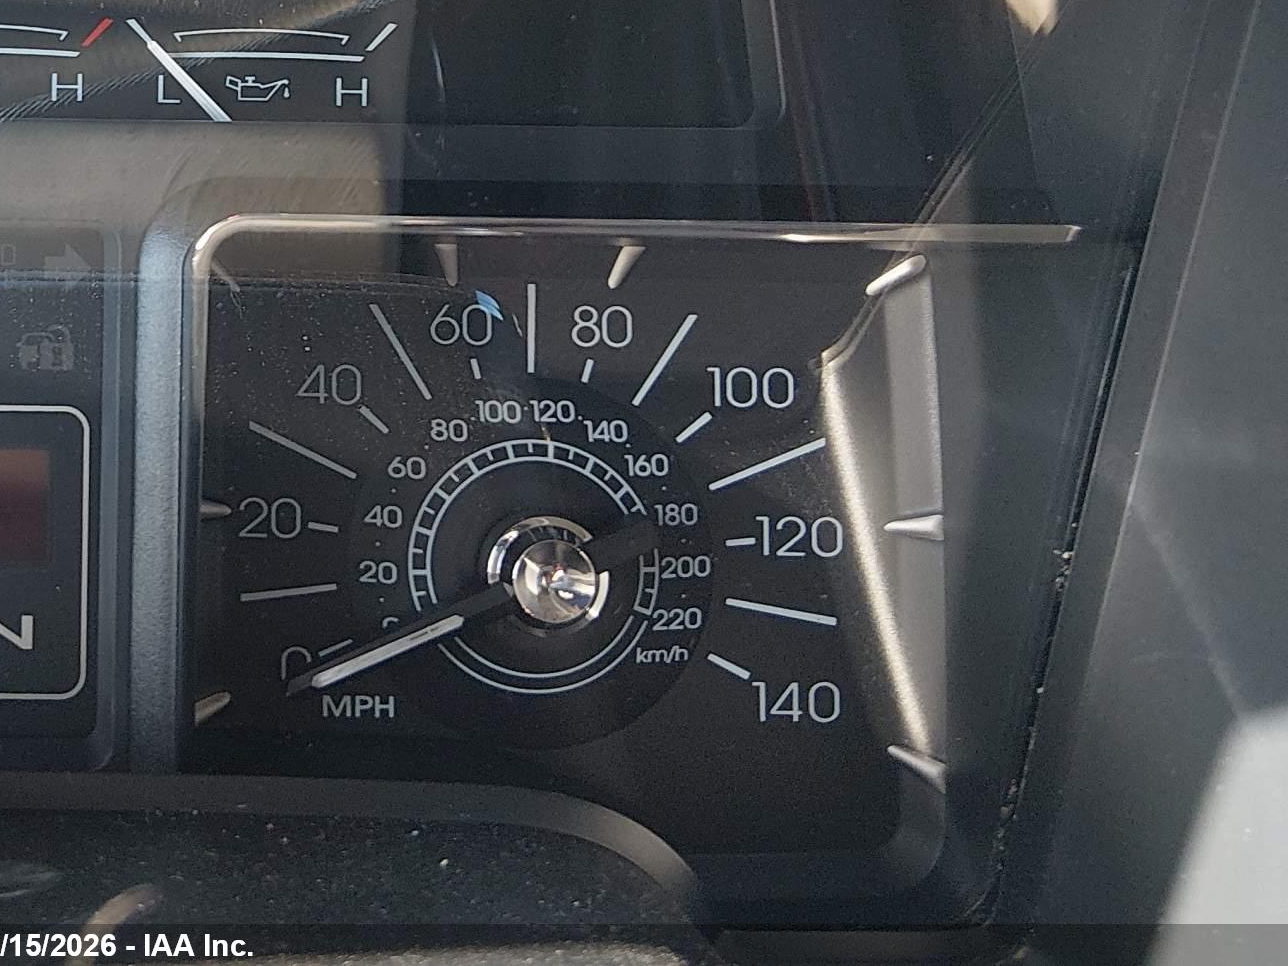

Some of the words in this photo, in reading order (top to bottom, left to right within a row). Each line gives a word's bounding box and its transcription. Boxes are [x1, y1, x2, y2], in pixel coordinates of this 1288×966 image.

[50, 72, 83, 102] H
[158, 74, 181, 104] L
[335, 78, 368, 107] H
[429, 303, 494, 346] 60
[570, 305, 634, 348] 80
[296, 364, 362, 407] 40
[708, 367, 795, 409] 100
[476, 399, 523, 424] 100
[531, 400, 576, 424] 120
[430, 418, 469, 443] 80
[584, 419, 629, 443] 140
[387, 457, 428, 481] 60
[624, 454, 669, 479] 160
[238, 497, 303, 539] 20
[363, 505, 404, 530] 40
[655, 502, 699, 527] 180
[755, 516, 845, 558] 120
[358, 560, 399, 586] 20
[661, 554, 711, 579] 200
[652, 607, 703, 631] 220
[635, 643, 690, 666] km/h
[322, 695, 395, 718] MPH
[751, 680, 842, 724] 140
